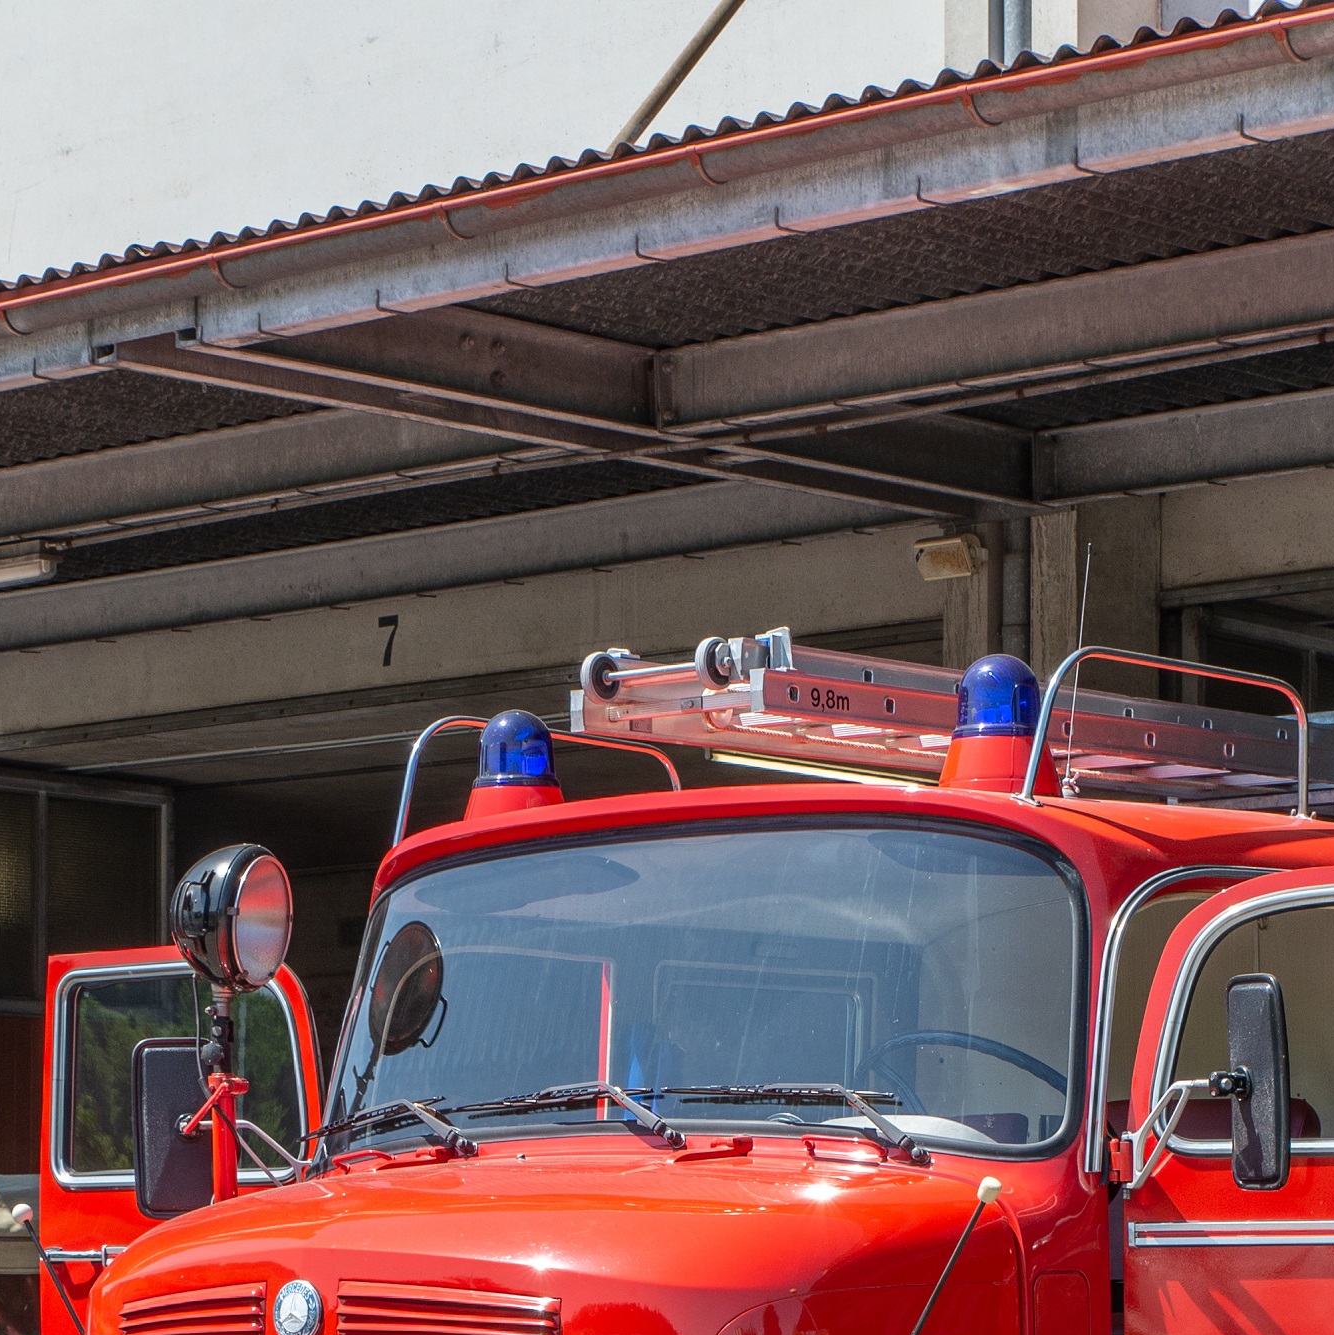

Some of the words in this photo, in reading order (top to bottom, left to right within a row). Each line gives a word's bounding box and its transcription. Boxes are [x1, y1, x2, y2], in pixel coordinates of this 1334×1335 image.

[378, 615, 399, 667] 7
[810, 687, 850, 712] 9,8m
[279, 1283, 312, 1300] MERCEDES
